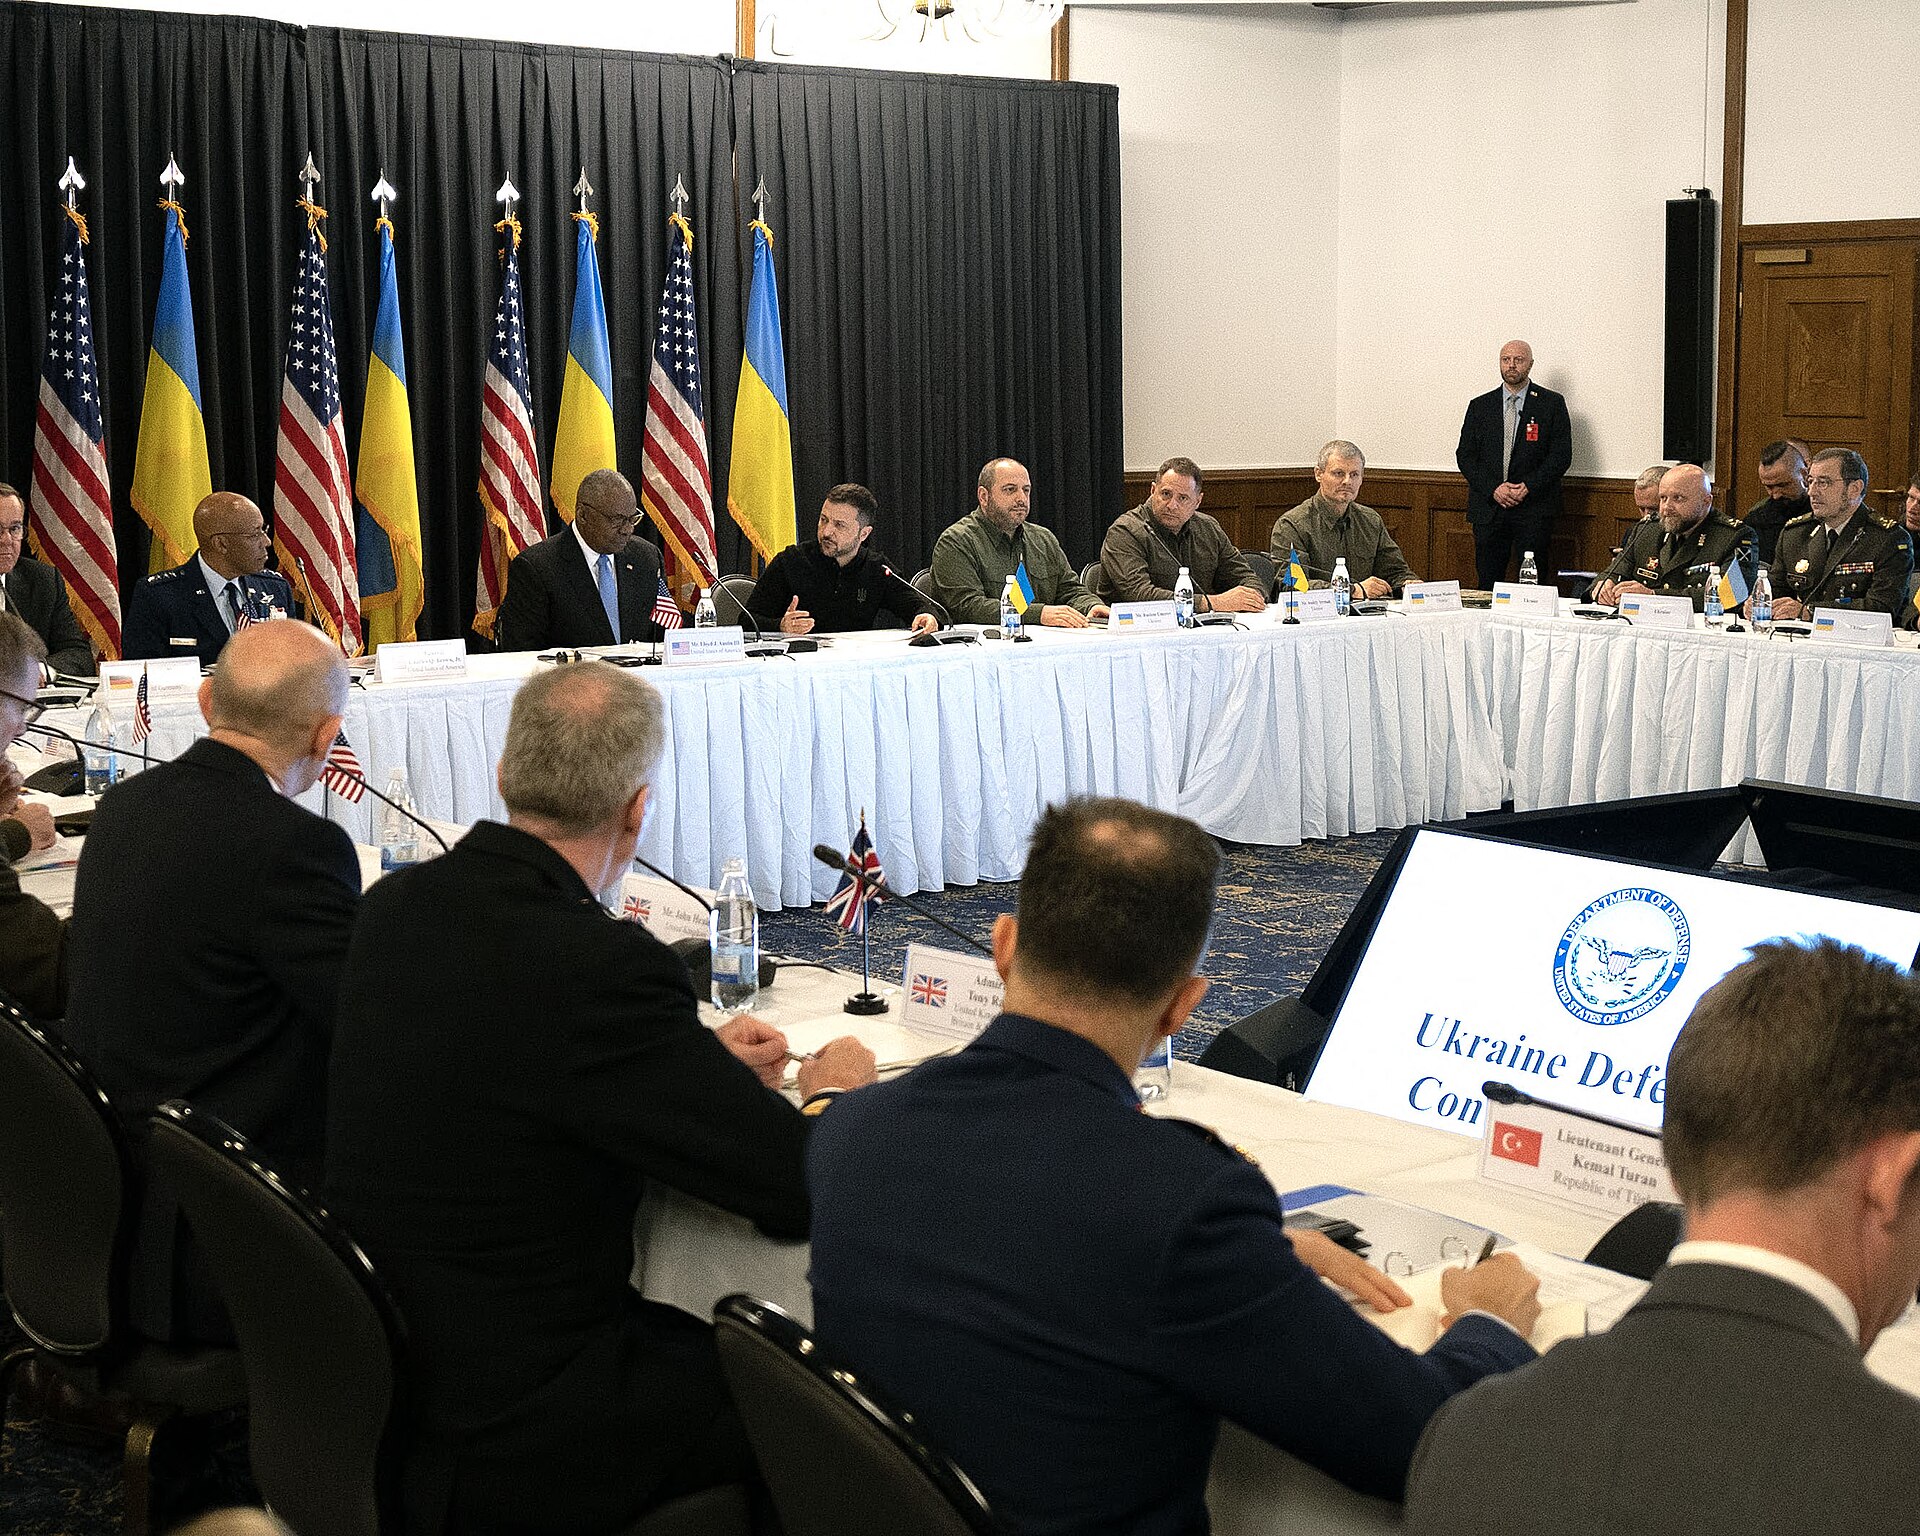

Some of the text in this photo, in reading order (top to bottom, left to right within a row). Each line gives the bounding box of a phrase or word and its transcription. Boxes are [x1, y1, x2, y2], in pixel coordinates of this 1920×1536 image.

[1564, 888, 1690, 964] DEPARTMENT OF DEFENSE
[1553, 965, 1670, 1025] UNITED STATES OF AMERICA
[1416, 1012, 1668, 1104] Ukraine Defe
[1408, 1076, 1484, 1124] Con
[1557, 1128, 1625, 1158] Lieutenant
[1553, 1169, 1603, 1196] Republic
[1608, 1186, 1622, 1200] of
[1572, 1153, 1657, 1187] Kemal Turan
